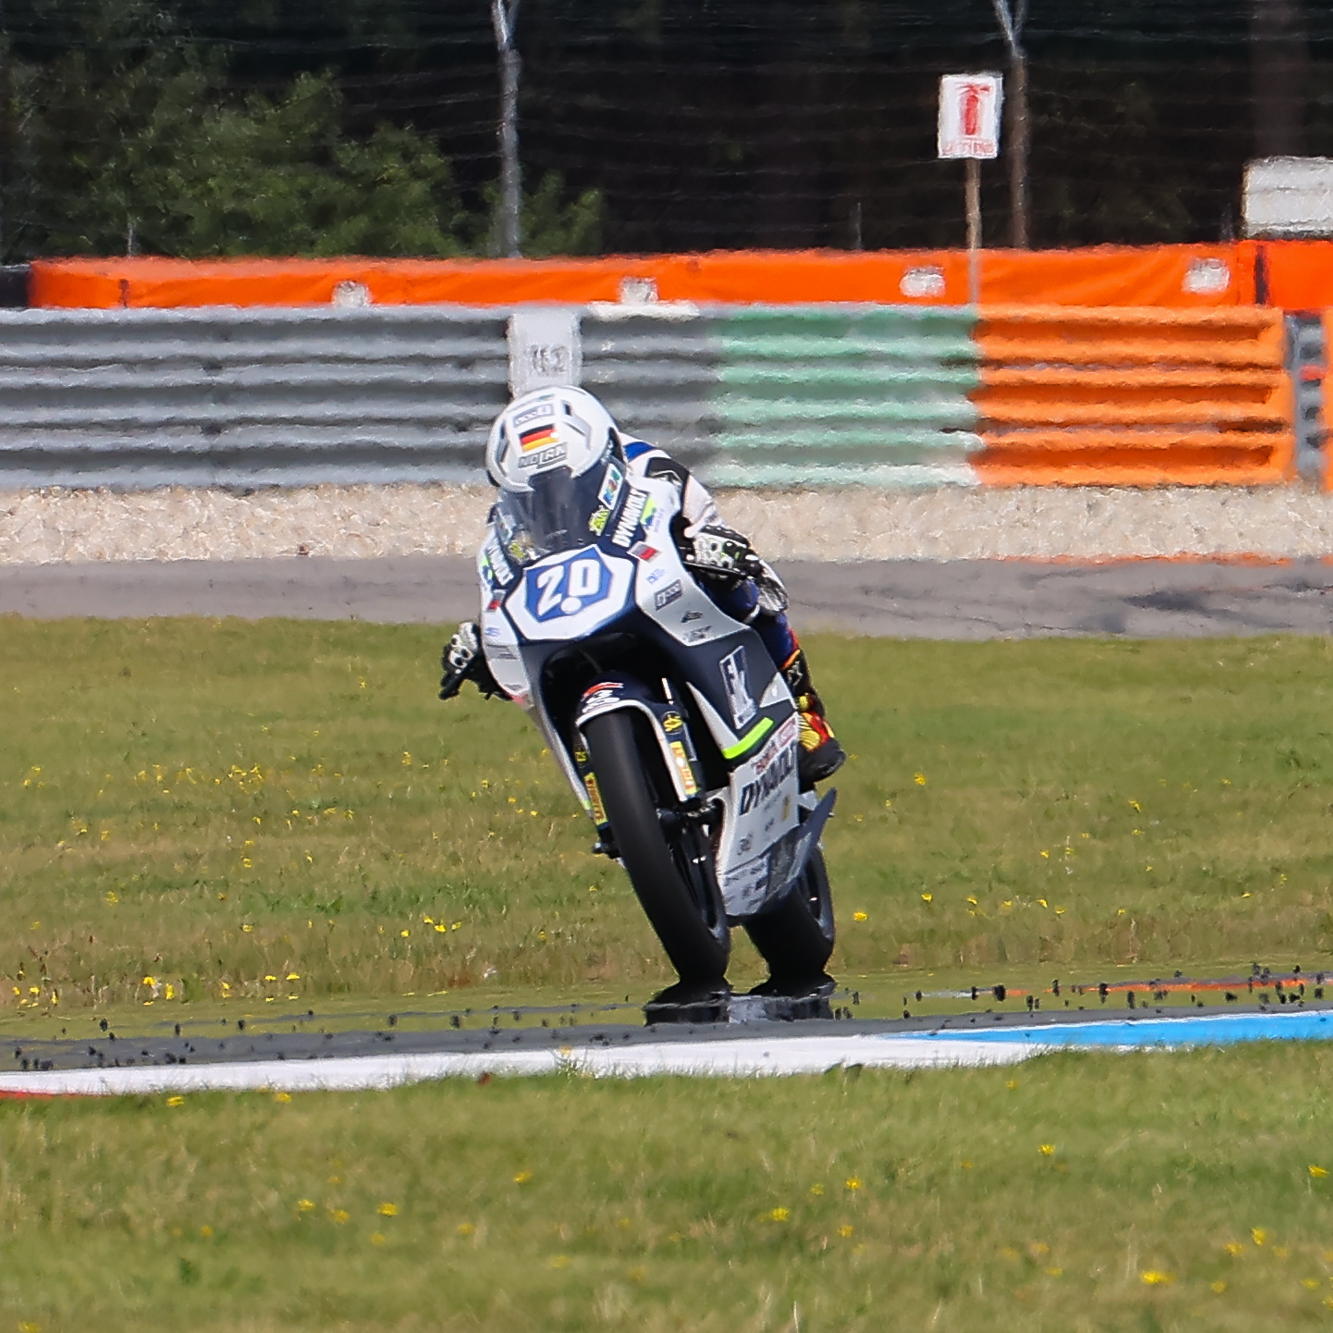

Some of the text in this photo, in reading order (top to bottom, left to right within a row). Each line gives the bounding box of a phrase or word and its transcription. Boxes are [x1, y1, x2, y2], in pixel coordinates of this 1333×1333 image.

[518, 443, 568, 469] NOLAN
[612, 486, 650, 549] DYNAVOLT
[536, 558, 601, 616] 20
